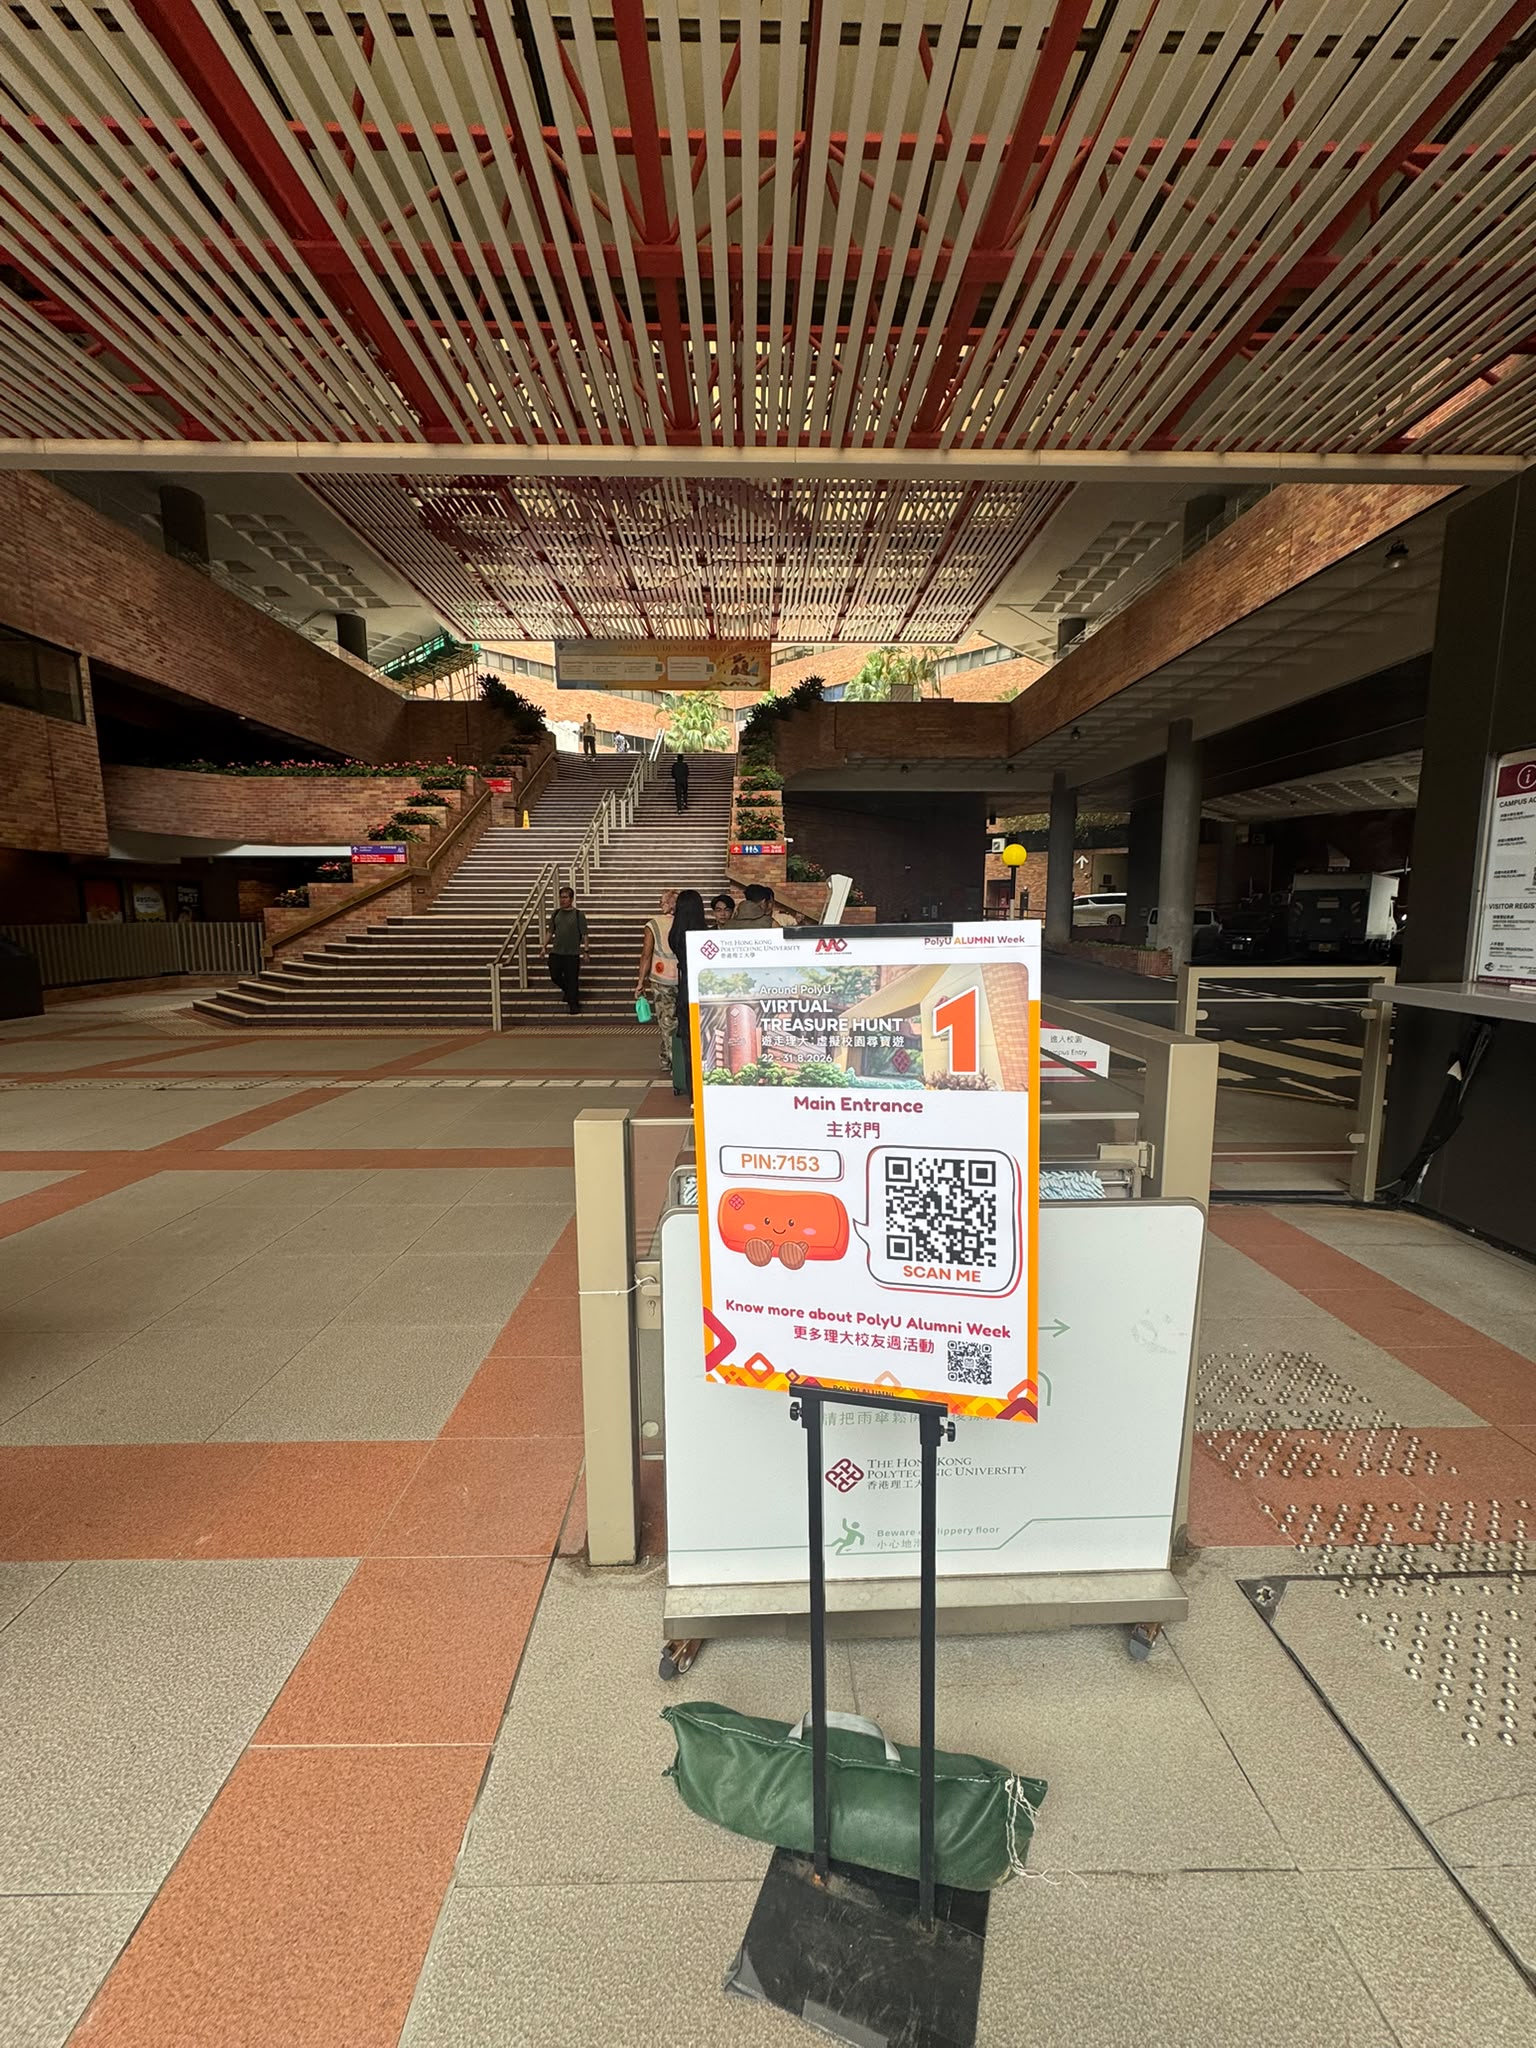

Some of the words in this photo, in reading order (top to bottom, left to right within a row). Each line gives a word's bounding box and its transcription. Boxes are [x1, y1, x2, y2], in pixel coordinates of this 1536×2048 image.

[1499, 797, 1527, 808] CAMPUS
[924, 936, 952, 947] PolyU
[954, 936, 994, 945] ALUMNI
[997, 935, 1025, 944] Week
[760, 985, 798, 994] Around
[800, 984, 834, 996] PolyU:
[760, 999, 833, 1013] VIRTUAL
[761, 1018, 848, 1032] TREASURE
[852, 1018, 903, 1031] HUNT
[934, 987, 978, 1074] 1
[762, 1053, 774, 1063] 22
[783, 1053, 833, 1063] 31.8.2026
[794, 1096, 835, 1112] Main
[841, 1097, 924, 1113] Entrance
[826, 1121, 881, 1139] 主校門
[741, 1153, 820, 1172] PIN:7153
[903, 1265, 951, 1281] SCAN
[956, 1268, 981, 1283] ME
[726, 1299, 763, 1314] Know
[768, 1304, 805, 1319] more
[809, 1307, 852, 1323] about
[856, 1312, 902, 1330] PolyU
[906, 1317, 962, 1334] Alumni
[966, 1322, 1011, 1339] Week
[793, 1325, 935, 1354] 更多理大校友週活動
[867, 1458, 893, 1468] THE
[937, 1457, 972, 1466] KONG
[867, 1469, 953, 1479] POLYTECIC
[955, 1466, 1027, 1477] UNIVERSITY
[877, 1529, 915, 1537] Beware
[937, 1527, 973, 1537] lippery
[975, 1525, 1000, 1534] floor
